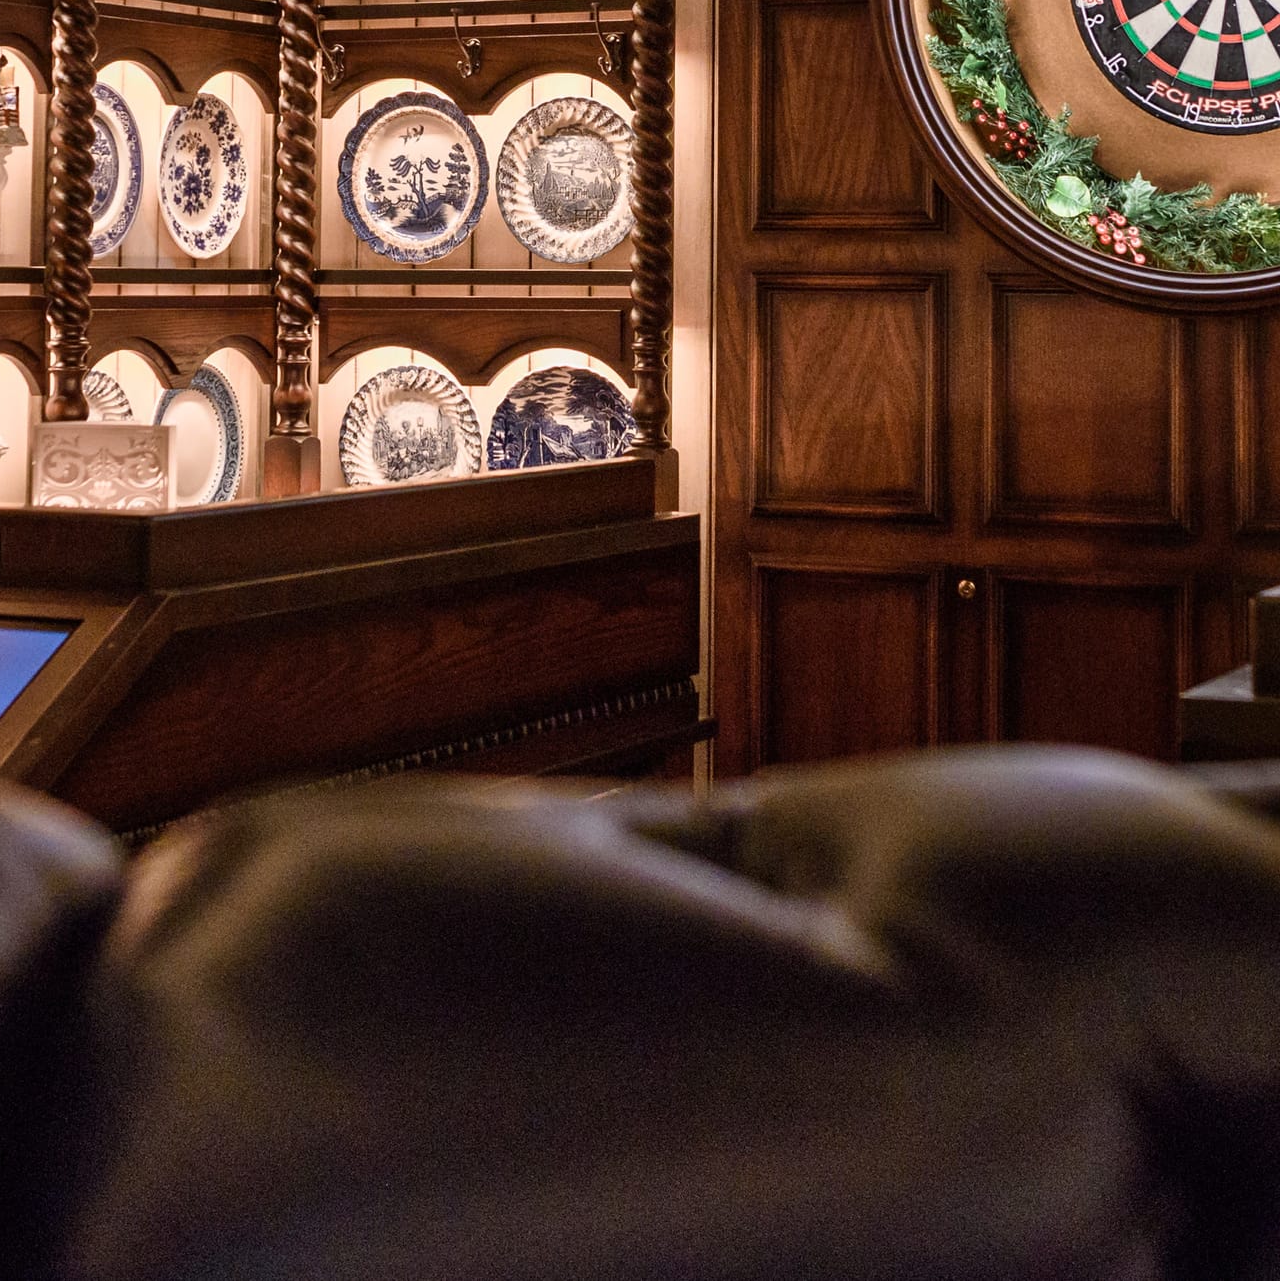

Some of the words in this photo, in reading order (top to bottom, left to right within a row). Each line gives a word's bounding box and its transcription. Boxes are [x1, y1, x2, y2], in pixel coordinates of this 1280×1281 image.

[1086, 13, 1104, 28] 8
[1103, 52, 1128, 75] 16
[1146, 84, 1158, 103] 7
[1151, 79, 1253, 113] ECLIPSE
[1231, 107, 1242, 127] 3
